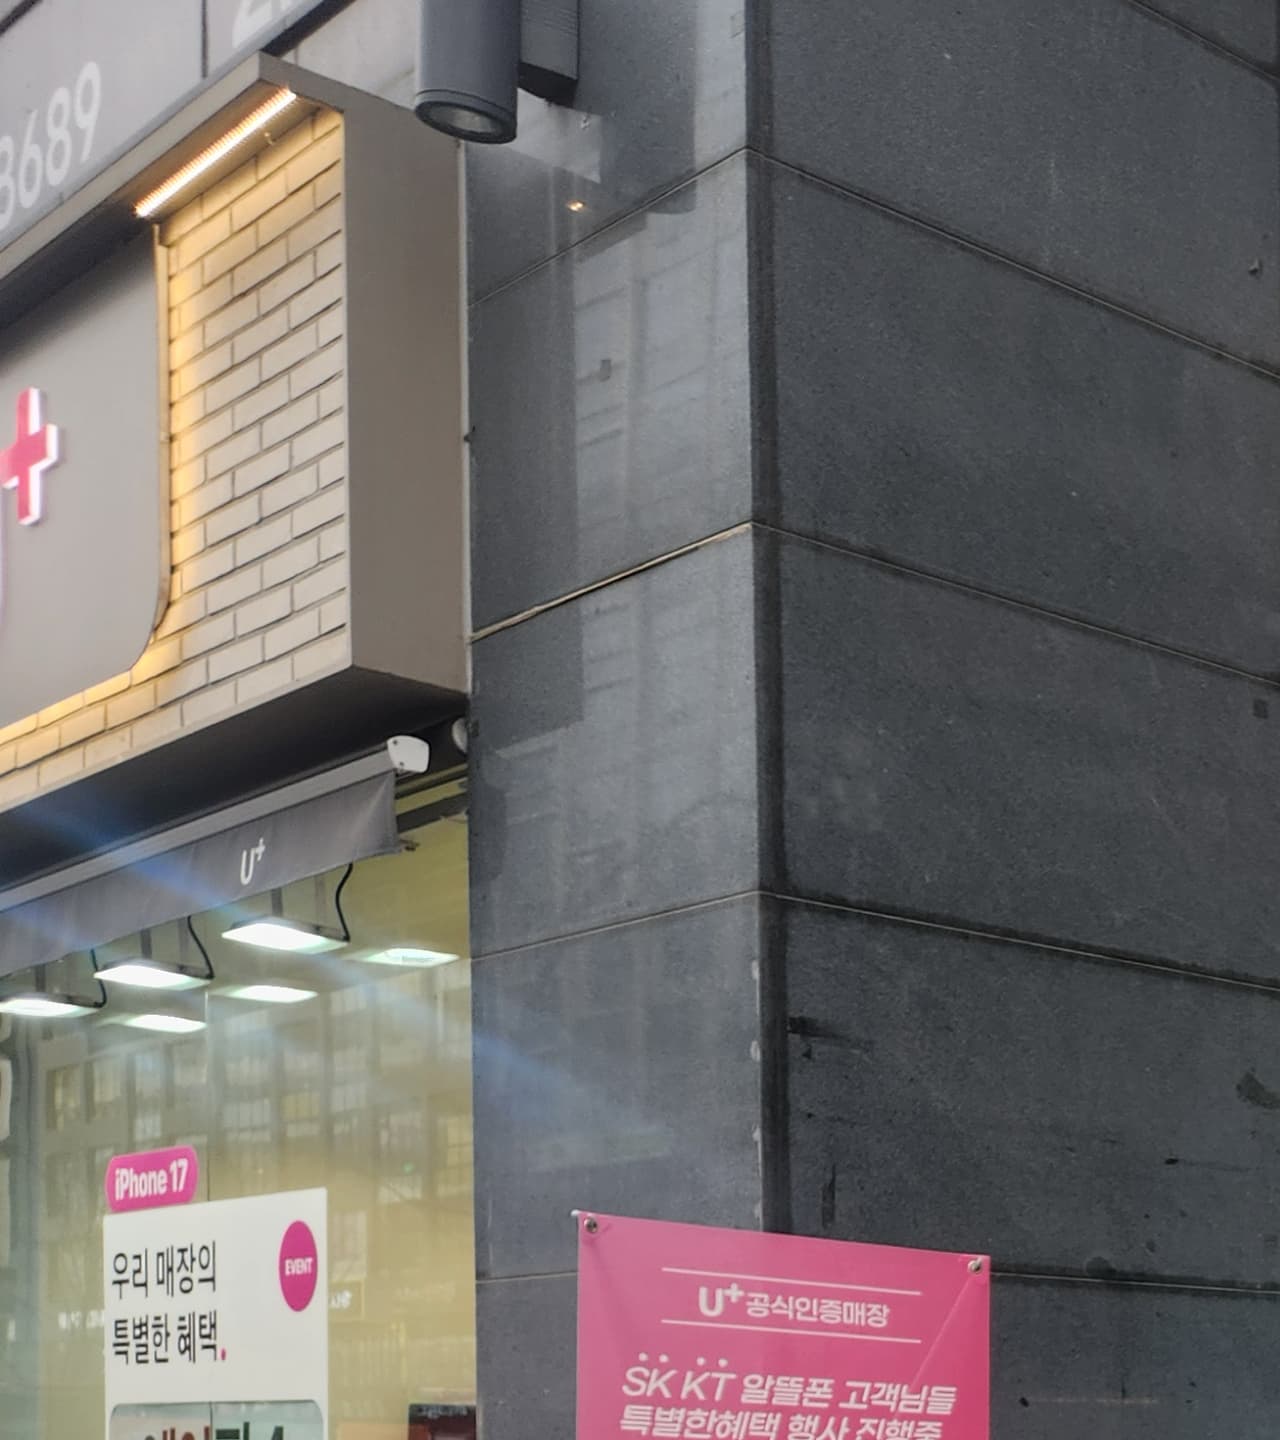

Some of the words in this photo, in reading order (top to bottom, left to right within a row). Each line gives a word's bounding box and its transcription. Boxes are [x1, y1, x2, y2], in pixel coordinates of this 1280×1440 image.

[240, 837, 267, 885] U+
[115, 1168, 167, 1201] iPhone
[170, 1158, 189, 1192] 17
[112, 1248, 149, 1300] 우리
[156, 1240, 217, 1298] 매장의
[284, 1257, 313, 1276] EVENT
[112, 1313, 171, 1365] 특별한
[622, 1366, 677, 1398] SK
[680, 1370, 737, 1401] KT
[741, 1374, 835, 1409] 알뜰폰
[839, 1379, 956, 1415] 고객님들
